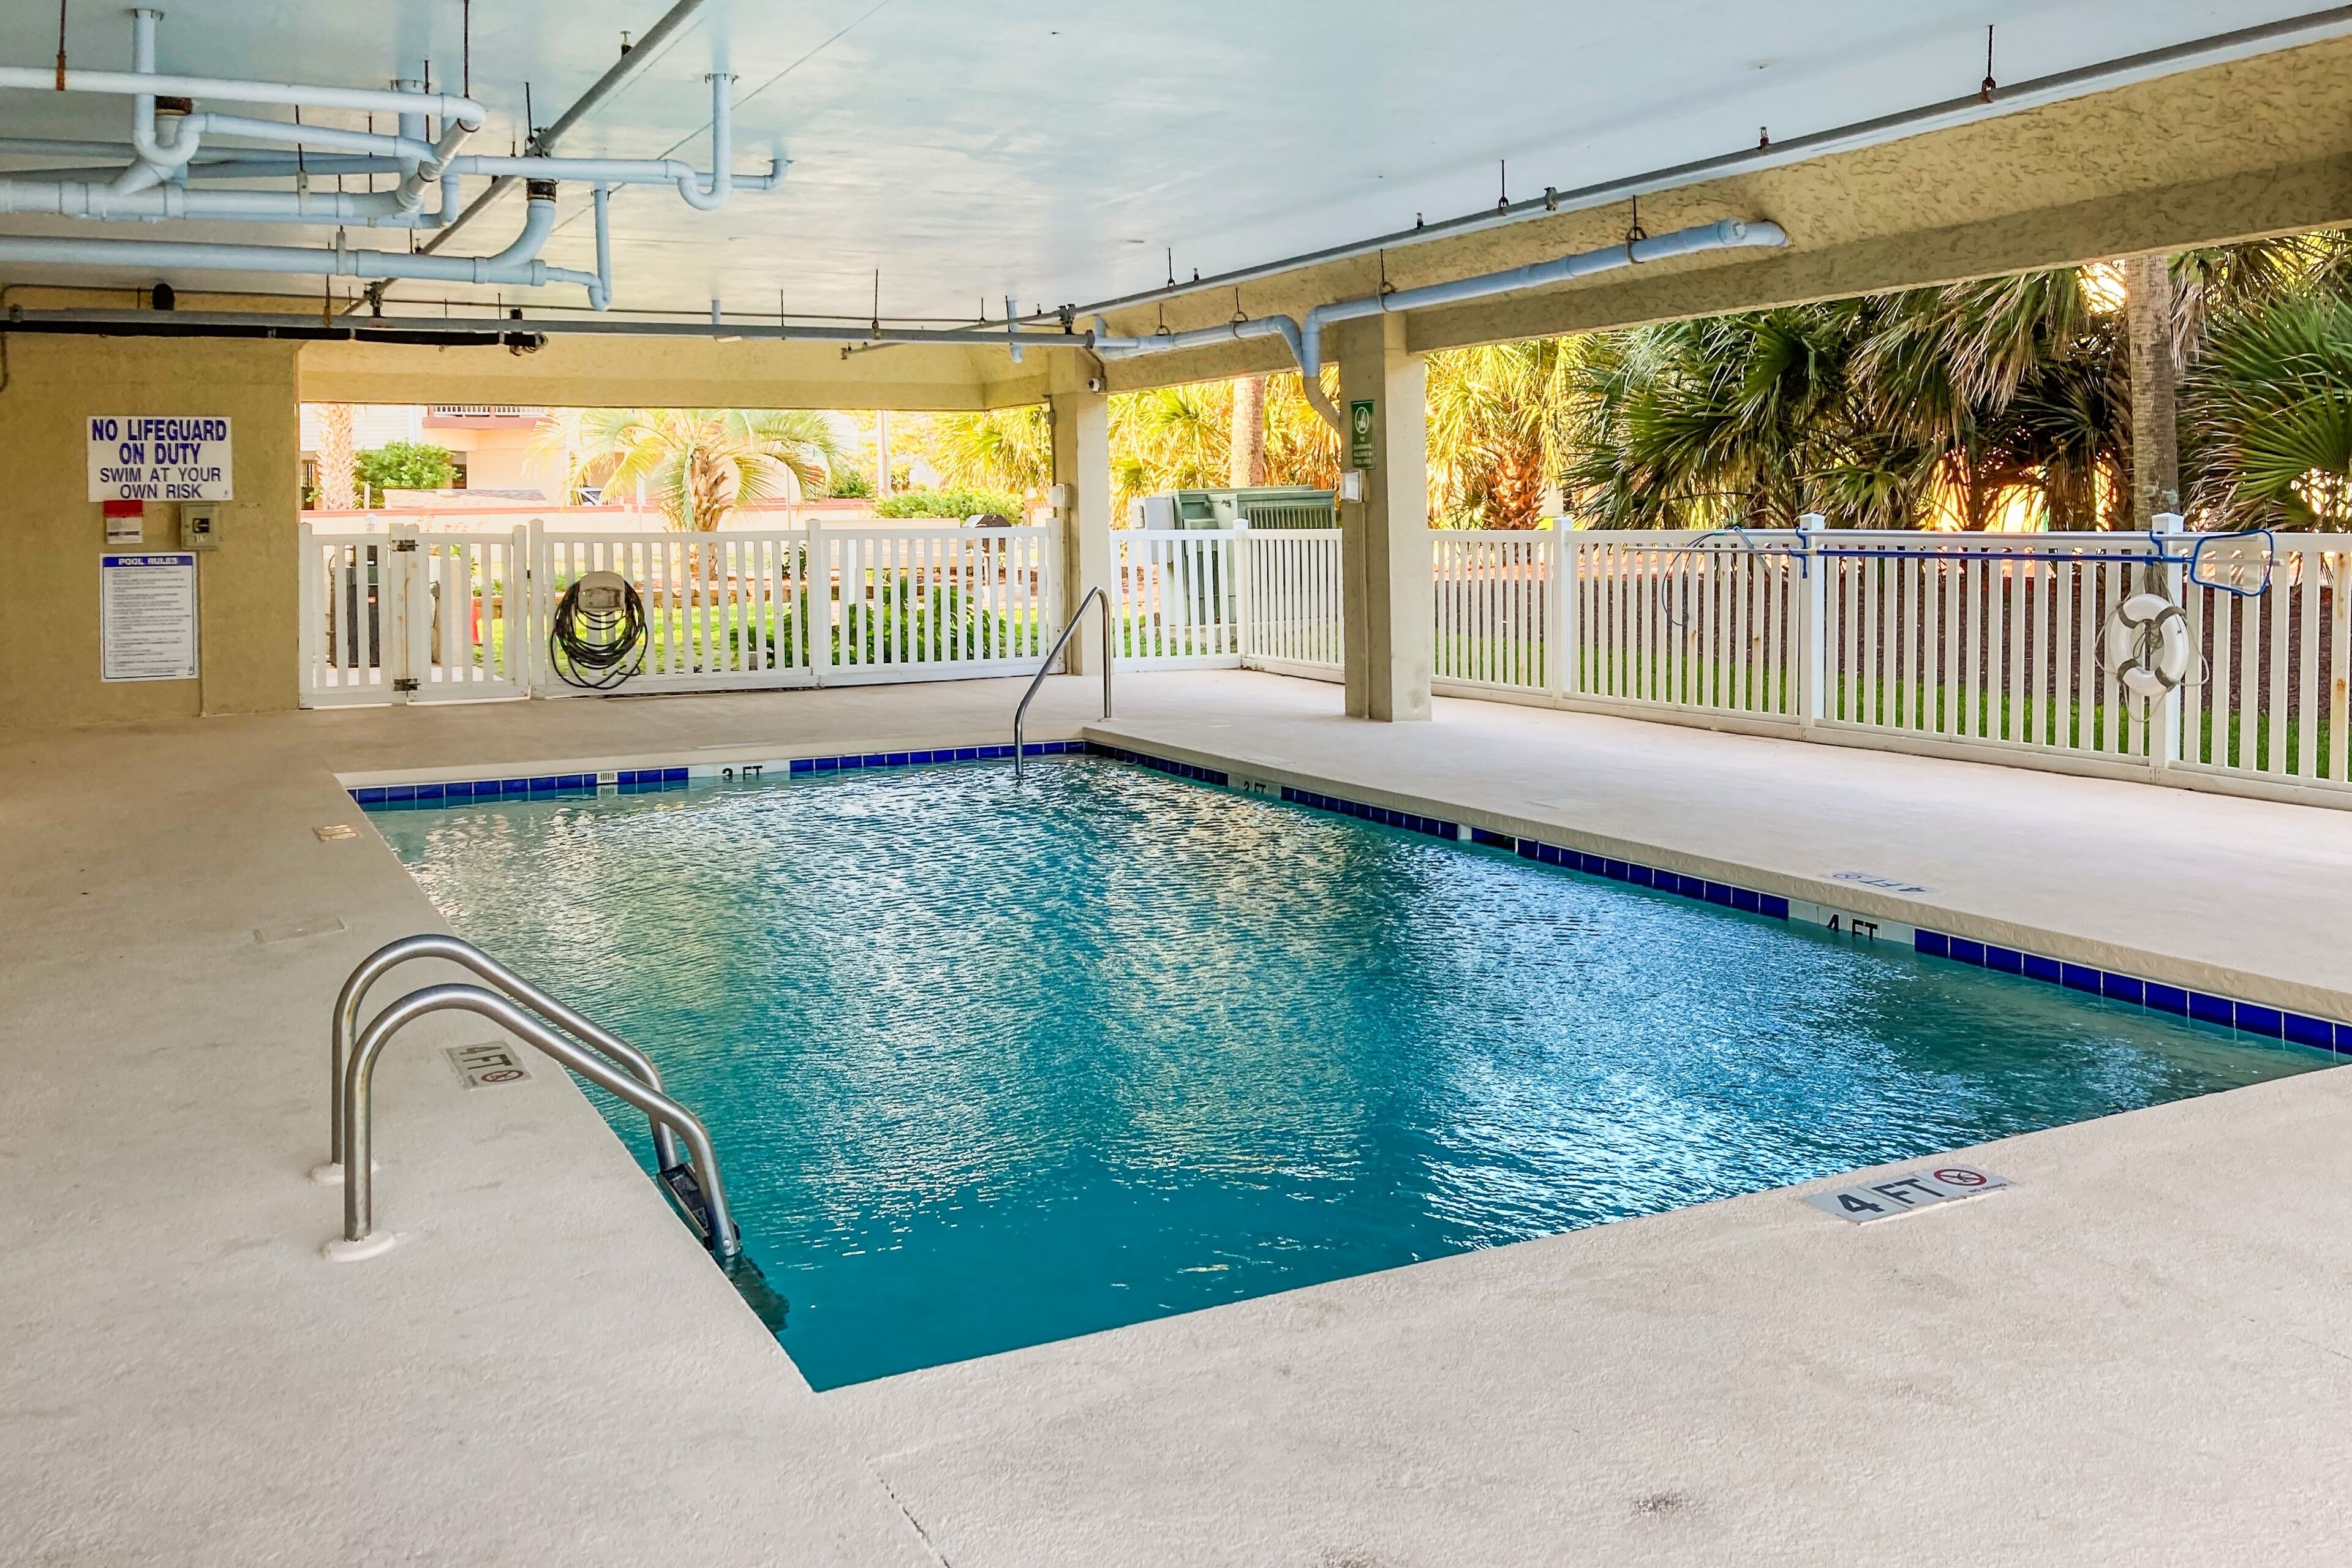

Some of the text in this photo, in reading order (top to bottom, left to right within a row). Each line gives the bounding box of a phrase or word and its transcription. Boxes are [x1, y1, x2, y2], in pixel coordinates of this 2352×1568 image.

[92, 419, 227, 441] NO LIFEGUARD
[119, 443, 201, 464] ON DUTY
[100, 467, 221, 483] SWIM AT YOUR
[120, 484, 202, 499] OWN RISK
[1852, 919, 1878, 940] FT
[462, 1054, 513, 1070] FT
[1837, 1178, 1945, 1212] 4 FT
